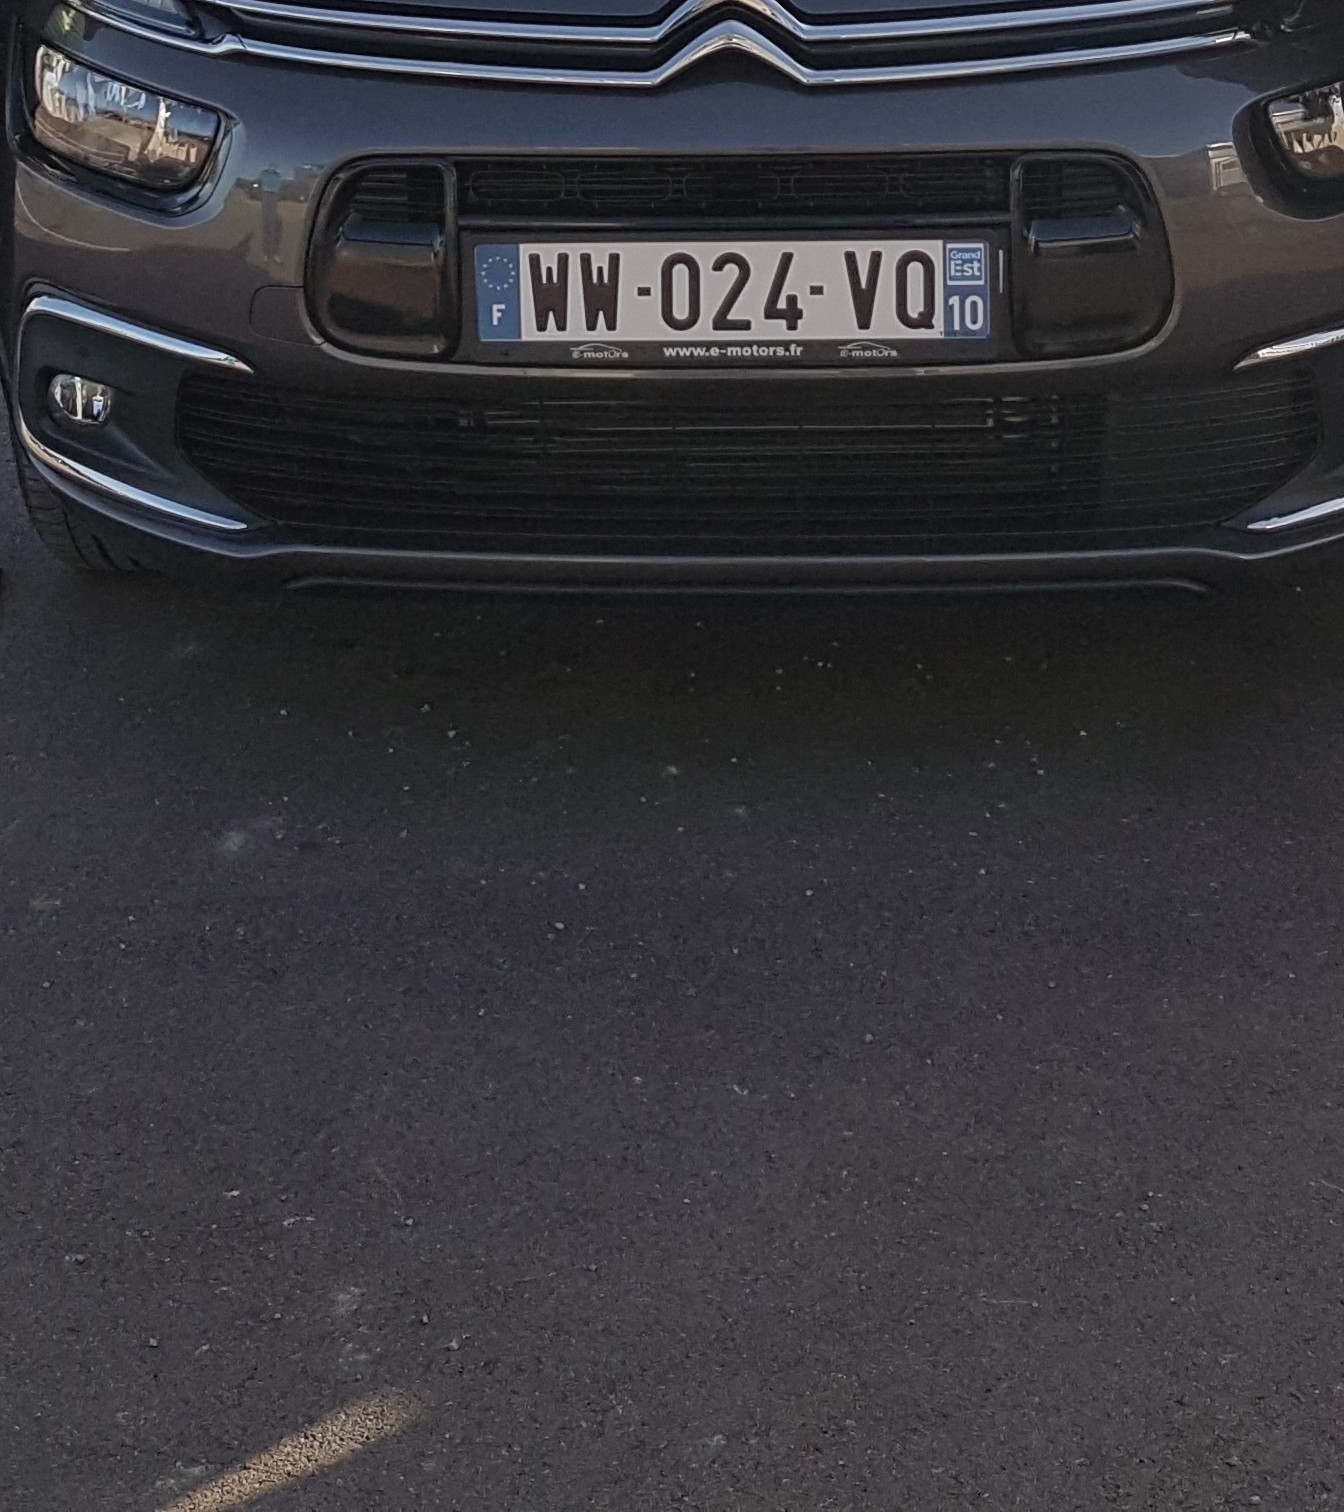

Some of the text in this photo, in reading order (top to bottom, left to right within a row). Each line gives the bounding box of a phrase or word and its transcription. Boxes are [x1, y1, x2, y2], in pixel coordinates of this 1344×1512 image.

[950, 250, 981, 260] Grand
[950, 260, 981, 277] Est
[528, 249, 936, 332] WW-024-VQ
[492, 304, 506, 326] F
[948, 294, 984, 331] 10
[663, 344, 803, 357] www.e-motors.fr
